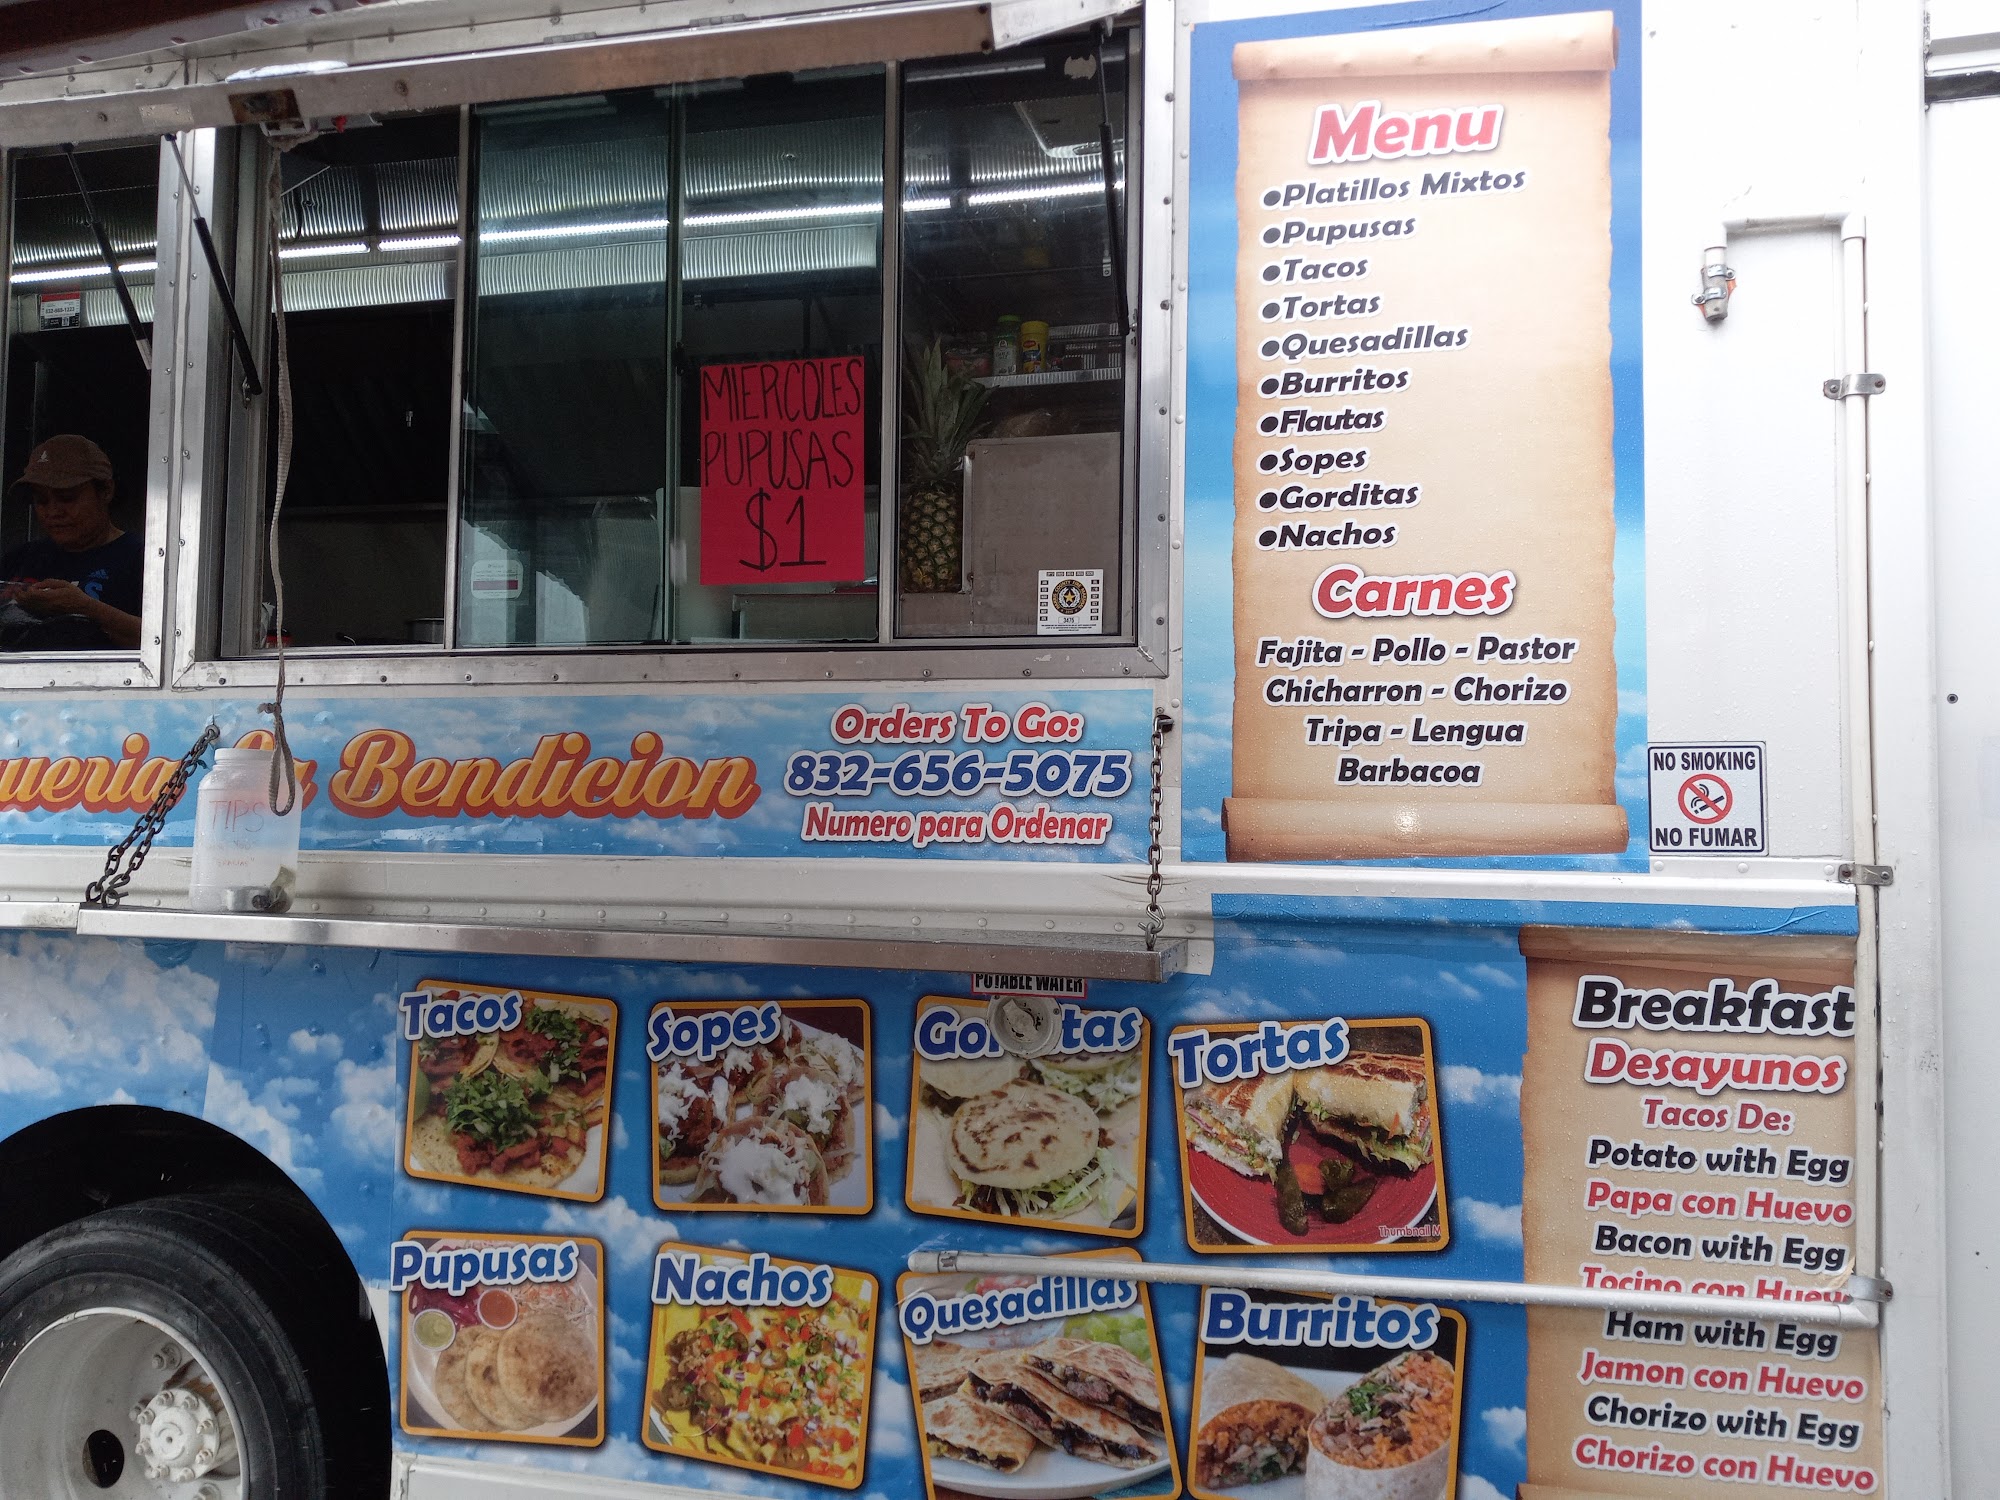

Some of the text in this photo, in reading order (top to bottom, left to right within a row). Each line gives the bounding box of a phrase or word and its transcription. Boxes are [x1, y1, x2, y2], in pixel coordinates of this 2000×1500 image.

[1313, 104, 1498, 160] Menu
[1283, 168, 1526, 207] Platillos Mixtos
[1282, 217, 1416, 246] Pupusas
[1282, 258, 1368, 281] Tacos
[1282, 295, 1380, 320] Tortas
[1281, 325, 1469, 360] Quesadillas
[703, 360, 862, 421] MIERCOLES
[1280, 369, 1409, 396] Burritos
[1280, 410, 1384, 433] Flautas
[705, 429, 854, 490] PUPUSAS
[1277, 448, 1367, 474] Sopes
[1279, 482, 1418, 509] Gorditas
[739, 487, 827, 573] $1
[1278, 522, 1396, 548] Nachos
[1317, 569, 1514, 614] Carnes
[1259, 640, 1342, 666] Fajita
[1372, 638, 1446, 662] Pollo
[1478, 636, 1575, 661] Pastor
[1266, 679, 1422, 703] Chicharron
[1454, 677, 1568, 702] Chorizo
[834, 706, 1080, 739] Orders To Go:
[1307, 718, 1380, 745] Tripa
[1412, 719, 1525, 746] Lengua
[329, 729, 761, 819] Bendicion
[788, 754, 1127, 792] 832-656-5075
[1338, 758, 1481, 784] Barbacoa
[1654, 751, 1756, 771] NO SMOKING
[209, 800, 266, 832] TIPS
[805, 805, 1107, 843] Numero para Ordenar
[1656, 828, 1757, 846] NO FUMAR
[975, 974, 1083, 993] POTABLE WATER
[403, 995, 518, 1036] Tacos
[1578, 980, 1855, 1033] Breakfast
[651, 1006, 778, 1058] Sopes
[919, 1010, 1138, 1055] Gotas
[1172, 1022, 1347, 1084] Tortas
[1590, 1043, 1843, 1090] Desayunos
[1644, 1098, 1792, 1132] Tacos De:
[1589, 1140, 1850, 1183] Potato with Egg
[1587, 1182, 1853, 1223] Papa con Huevo
[1379, 1225, 1431, 1237] Thumbnail
[1596, 1226, 1846, 1272] Bacon with Egg
[393, 1245, 578, 1291] Pupusas
[656, 1258, 831, 1302] Nachos
[1583, 1266, 1681, 1293] Tocino
[1692, 1283, 1745, 1298] con
[909, 1277, 1136, 1338] Quesadillas
[1207, 1294, 1436, 1344] Burritos
[1606, 1311, 1837, 1356] Ham with Egg
[1581, 1351, 1864, 1399] Jamon con Huevo
[1587, 1396, 1859, 1447] Chorizo with Egg
[1576, 1439, 1874, 1489] Chorizo con Huevo
